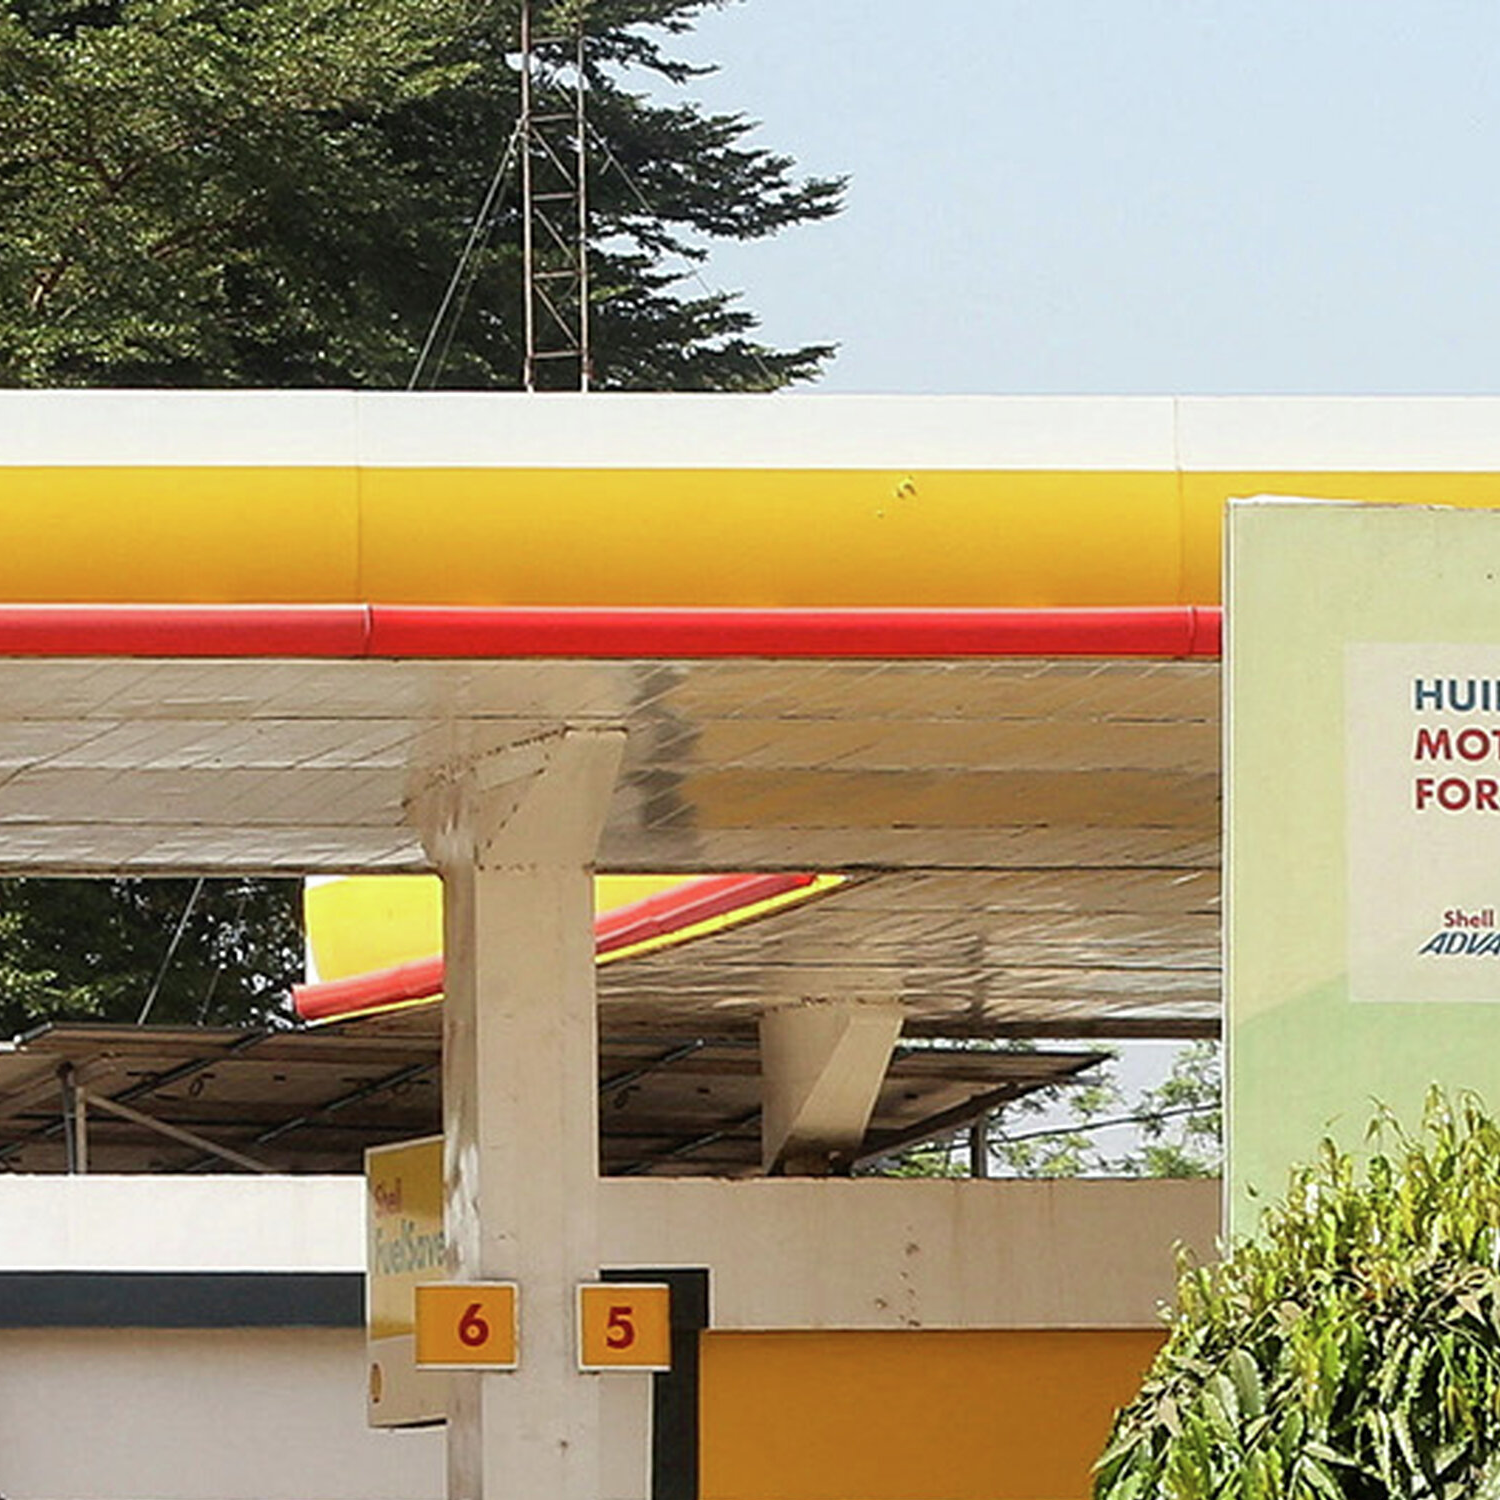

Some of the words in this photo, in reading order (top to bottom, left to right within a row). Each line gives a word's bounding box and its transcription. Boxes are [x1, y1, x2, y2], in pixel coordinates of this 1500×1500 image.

[1415, 679, 1500, 711] HUI
[1443, 908, 1494, 928] Shell
[458, 1303, 489, 1347] 6
[605, 1306, 636, 1349] 5
